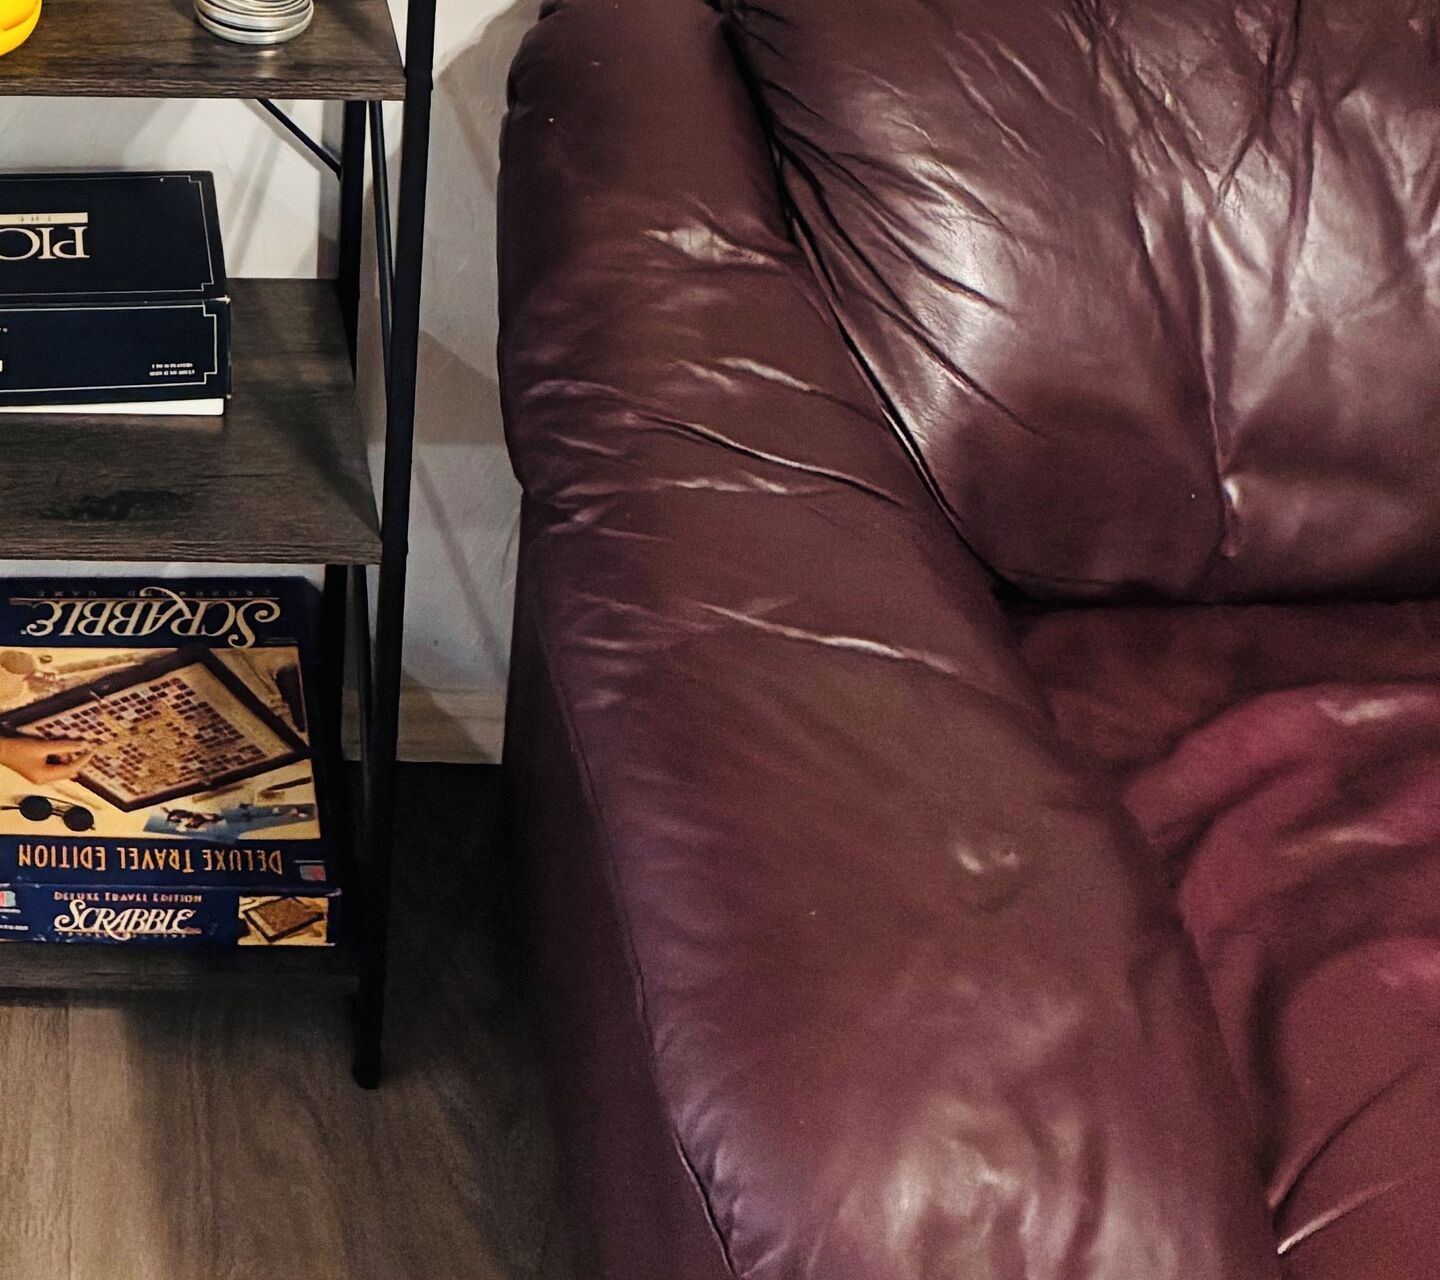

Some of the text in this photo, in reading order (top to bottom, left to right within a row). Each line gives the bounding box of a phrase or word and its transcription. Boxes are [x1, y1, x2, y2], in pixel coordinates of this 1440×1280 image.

[20, 215, 52, 223] THE
[26, 586, 281, 649] SCRABBLE
[18, 844, 106, 871] EDITION
[116, 847, 195, 873] TRAVEL
[202, 849, 282, 875] DELUXE
[54, 891, 202, 903] DELUXE TRAVEL EDITION
[54, 899, 197, 941] SCRABBLE
